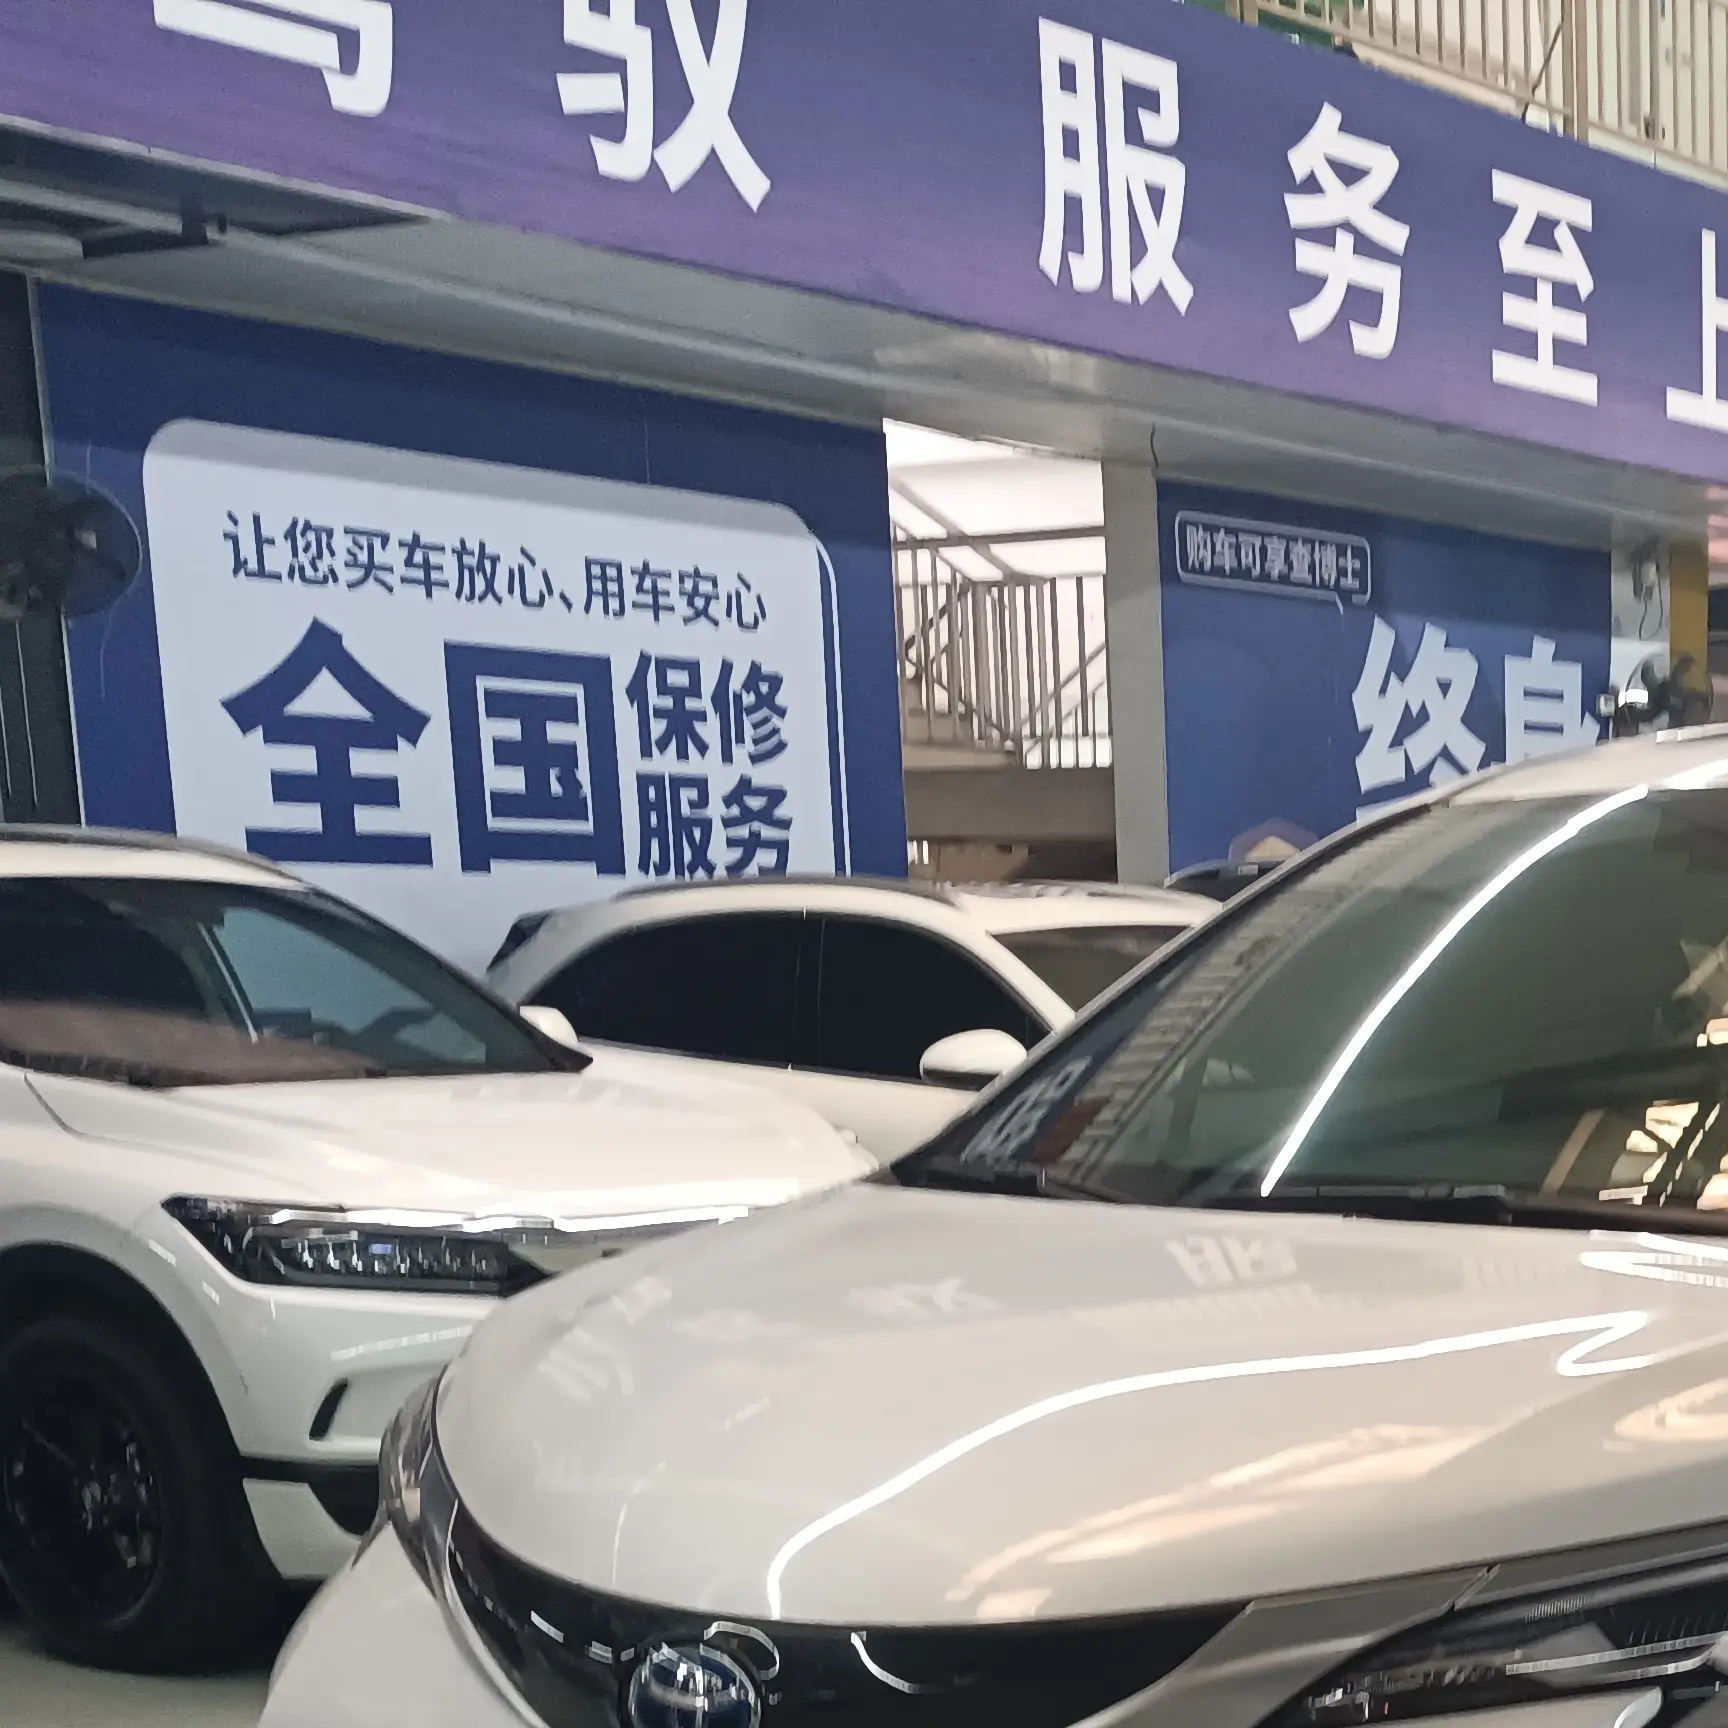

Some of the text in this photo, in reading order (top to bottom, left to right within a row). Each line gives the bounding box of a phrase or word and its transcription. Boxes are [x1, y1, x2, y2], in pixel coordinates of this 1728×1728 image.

[152, 0, 771, 212] 驭
[222, 510, 767, 632] 让您买车放心、用车安心
[1186, 523, 1361, 590] 购车可享查博士
[220, 616, 627, 878] 全国
[625, 649, 788, 767] 保修
[635, 771, 794, 880] 服务
